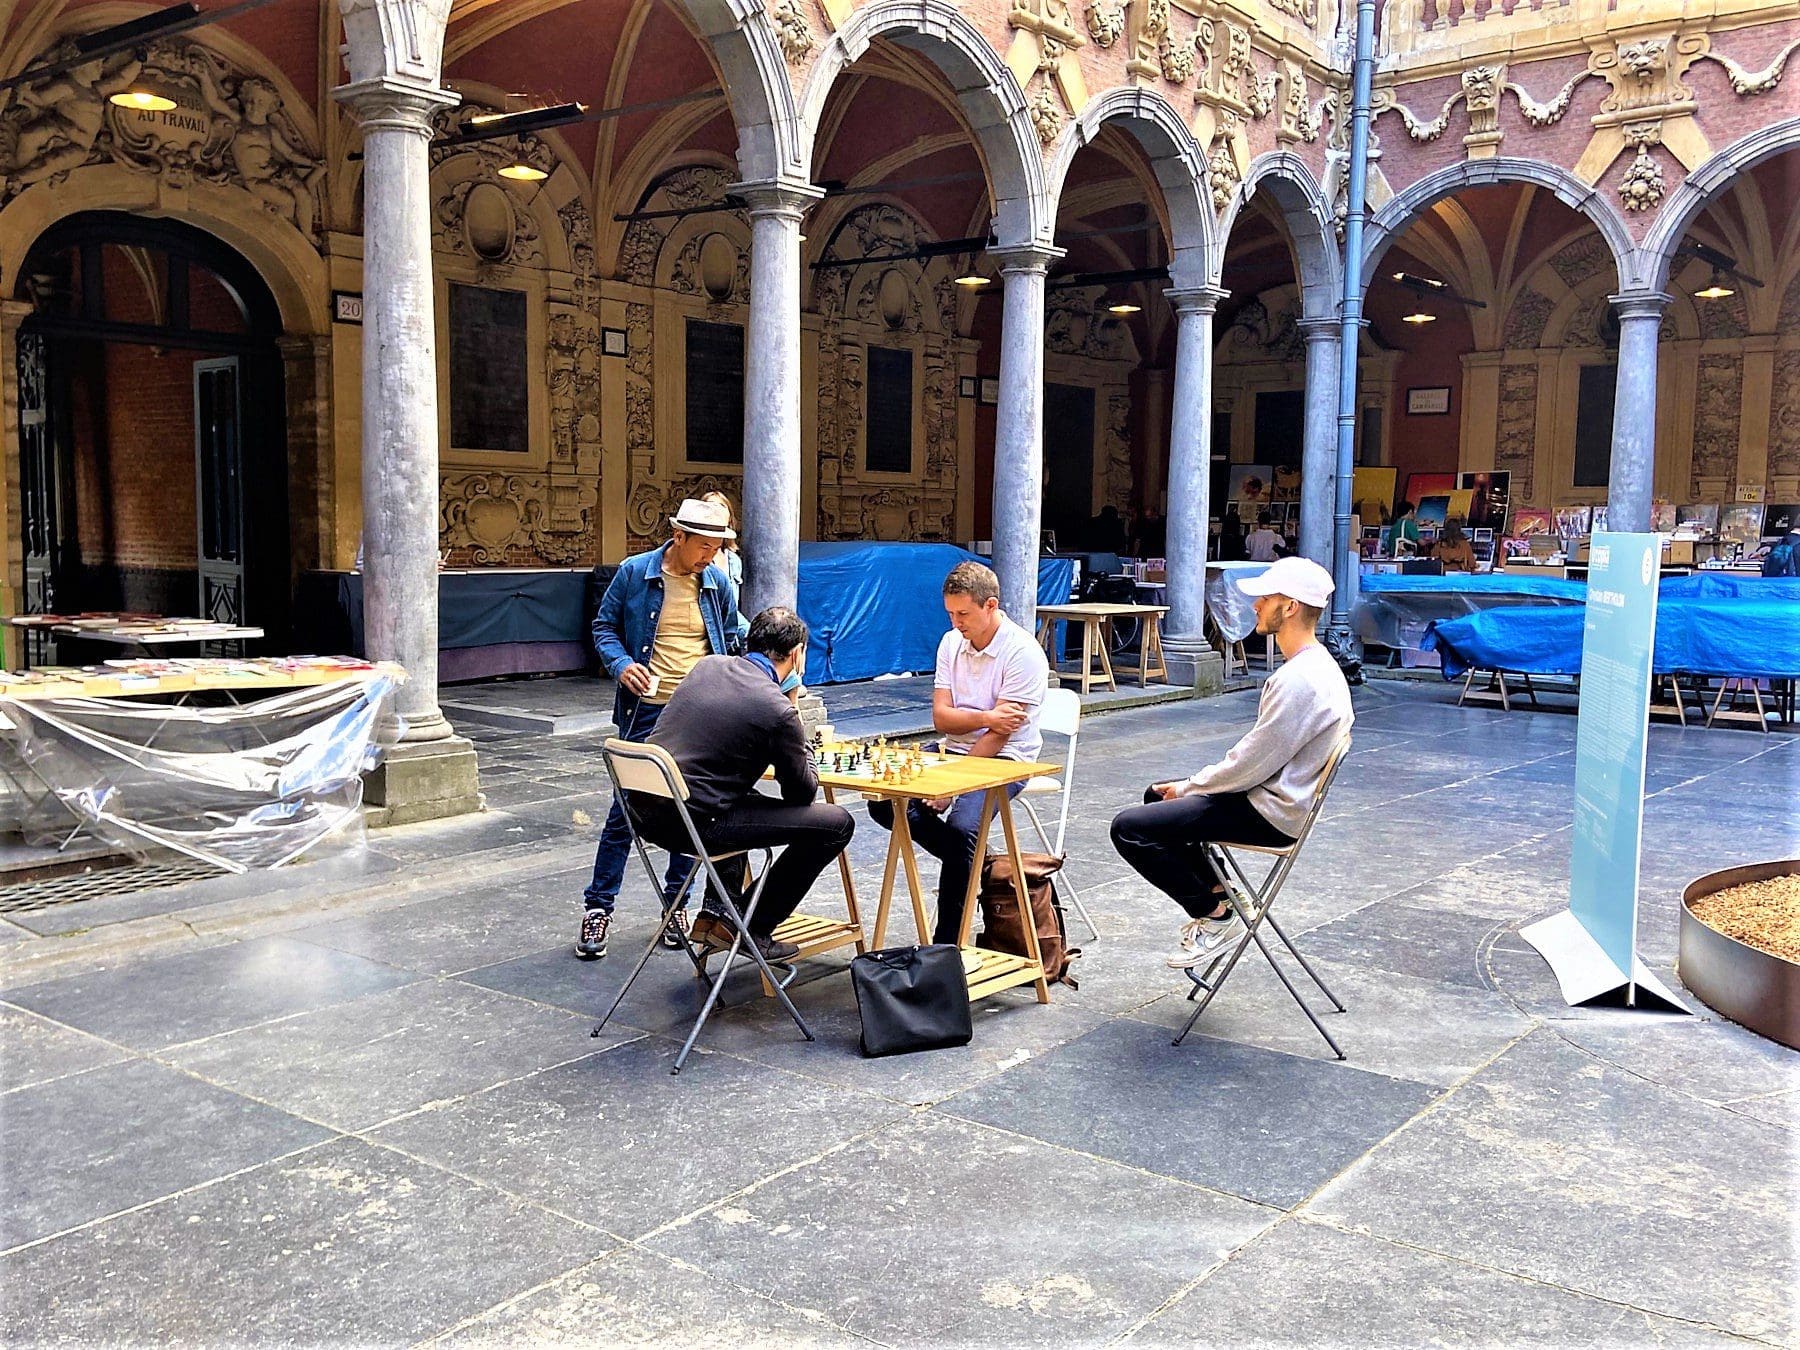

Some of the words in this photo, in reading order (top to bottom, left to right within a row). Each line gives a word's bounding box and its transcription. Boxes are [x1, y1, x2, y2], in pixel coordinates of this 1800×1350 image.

[138, 109, 156, 122] AU
[161, 111, 205, 133] TRAVAIL
[341, 301, 360, 317] 20
